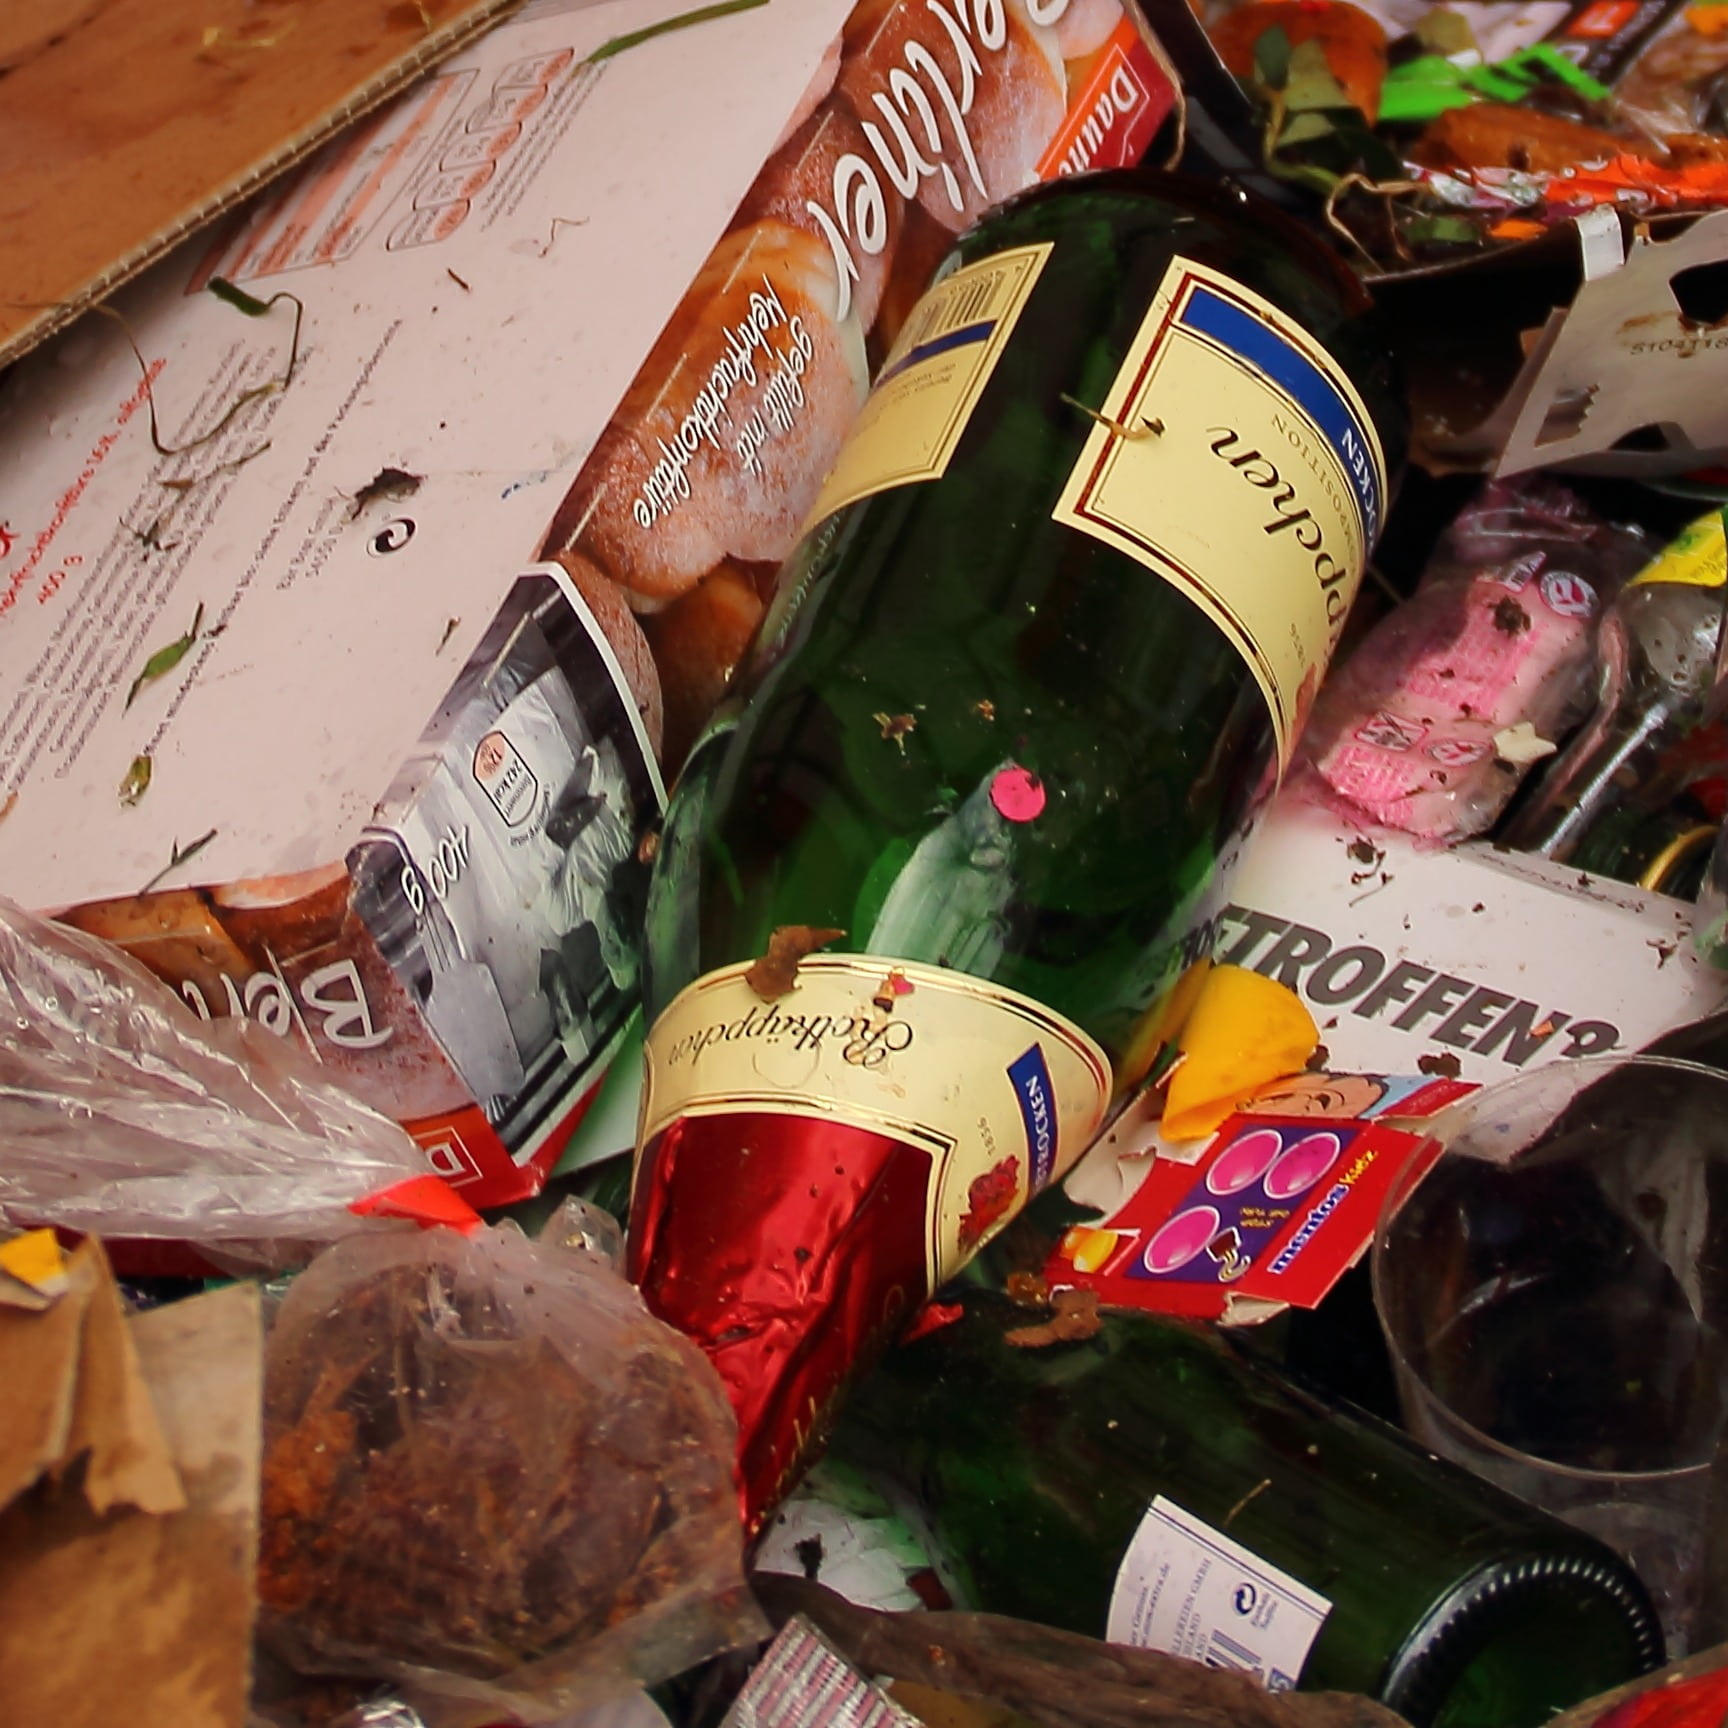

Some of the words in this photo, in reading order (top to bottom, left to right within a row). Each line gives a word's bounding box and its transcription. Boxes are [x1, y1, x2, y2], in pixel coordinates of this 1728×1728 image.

[627, 277, 790, 535] Mehrfruchtkonfitüre
[754, 313, 827, 433] gefüllt
[729, 404, 779, 483] mit
[388, 860, 441, 918] g
[414, 821, 475, 901] 400
[667, 1005, 912, 1065] Rotkäppchen
[1268, 1183, 1350, 1275] mentos
